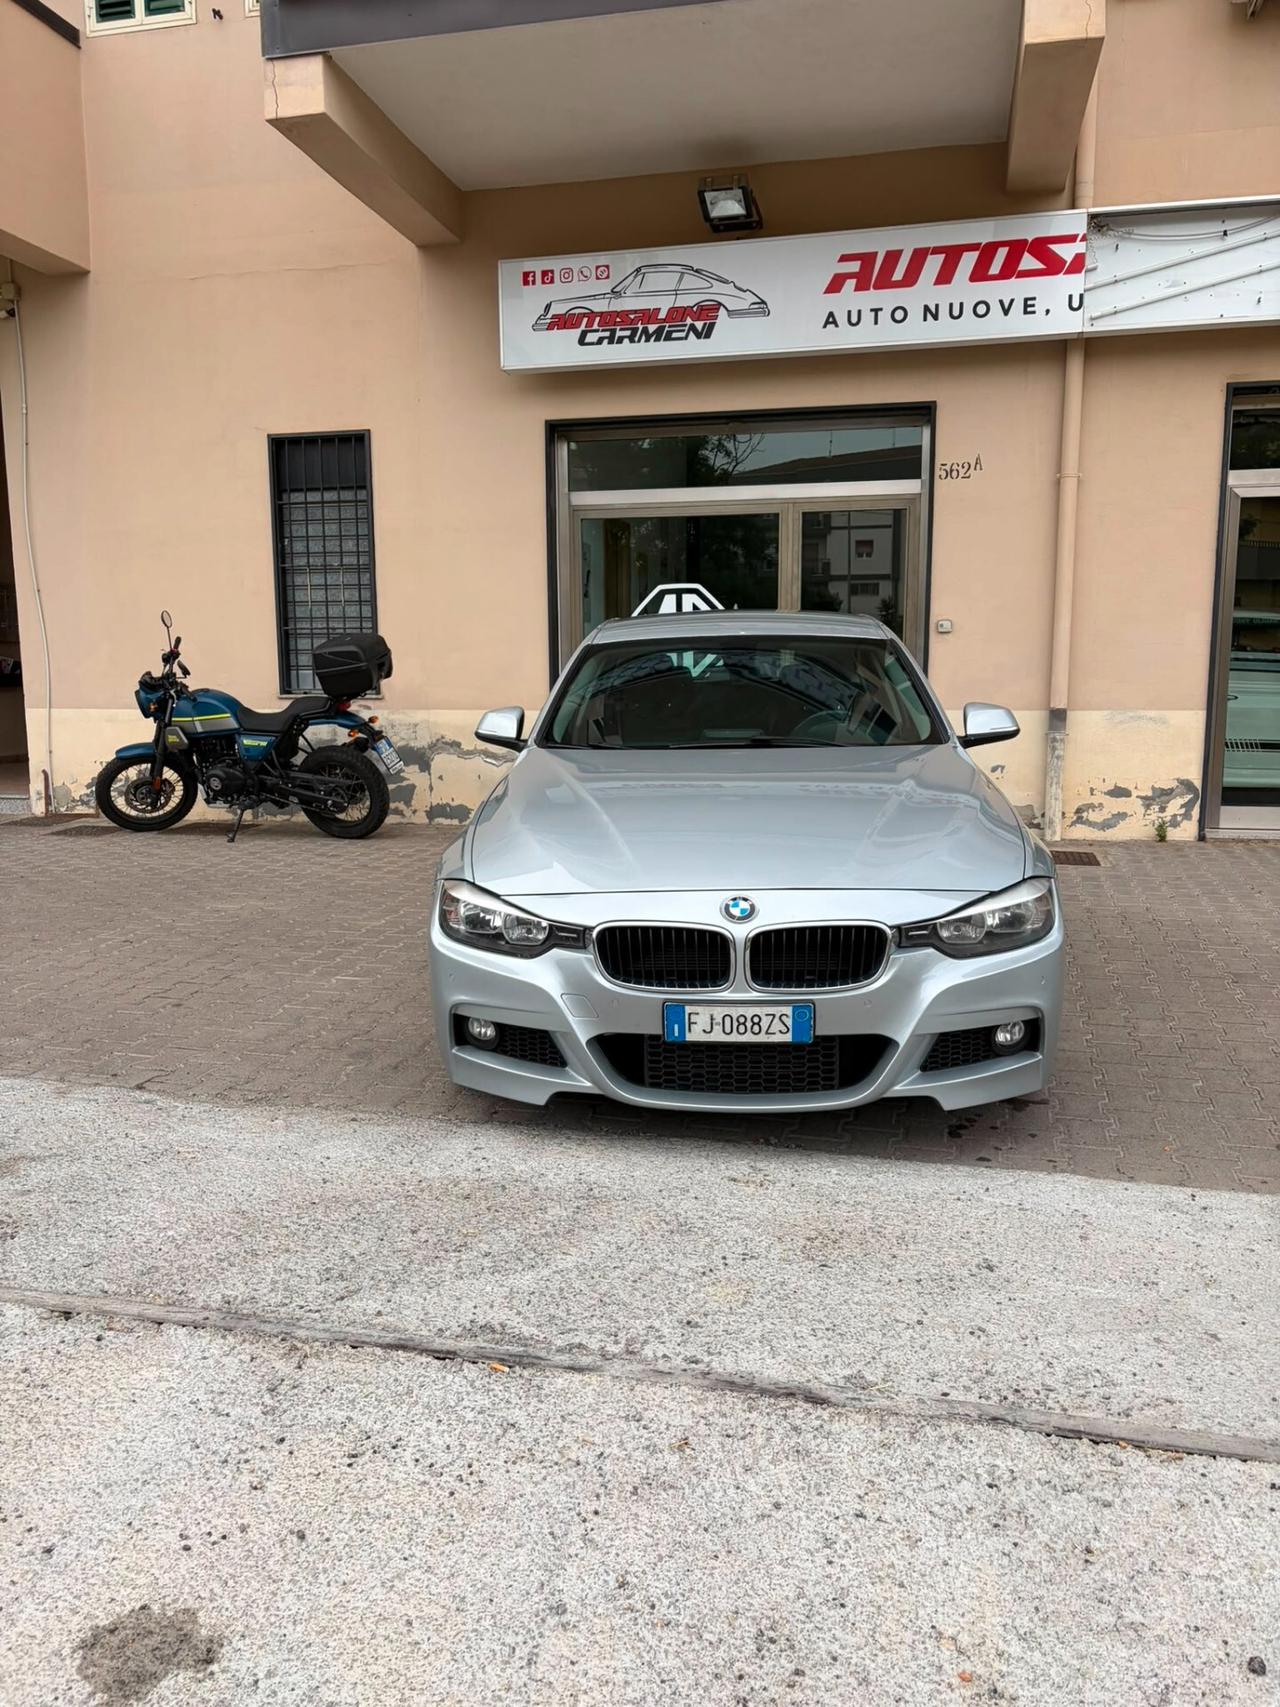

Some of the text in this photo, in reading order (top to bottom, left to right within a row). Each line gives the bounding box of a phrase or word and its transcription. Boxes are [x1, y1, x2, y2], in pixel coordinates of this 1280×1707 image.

[547, 304, 721, 331] AUTOSALONE
[822, 293, 1084, 329] AUTO NUOVE, U
[578, 322, 716, 346] CARMENI
